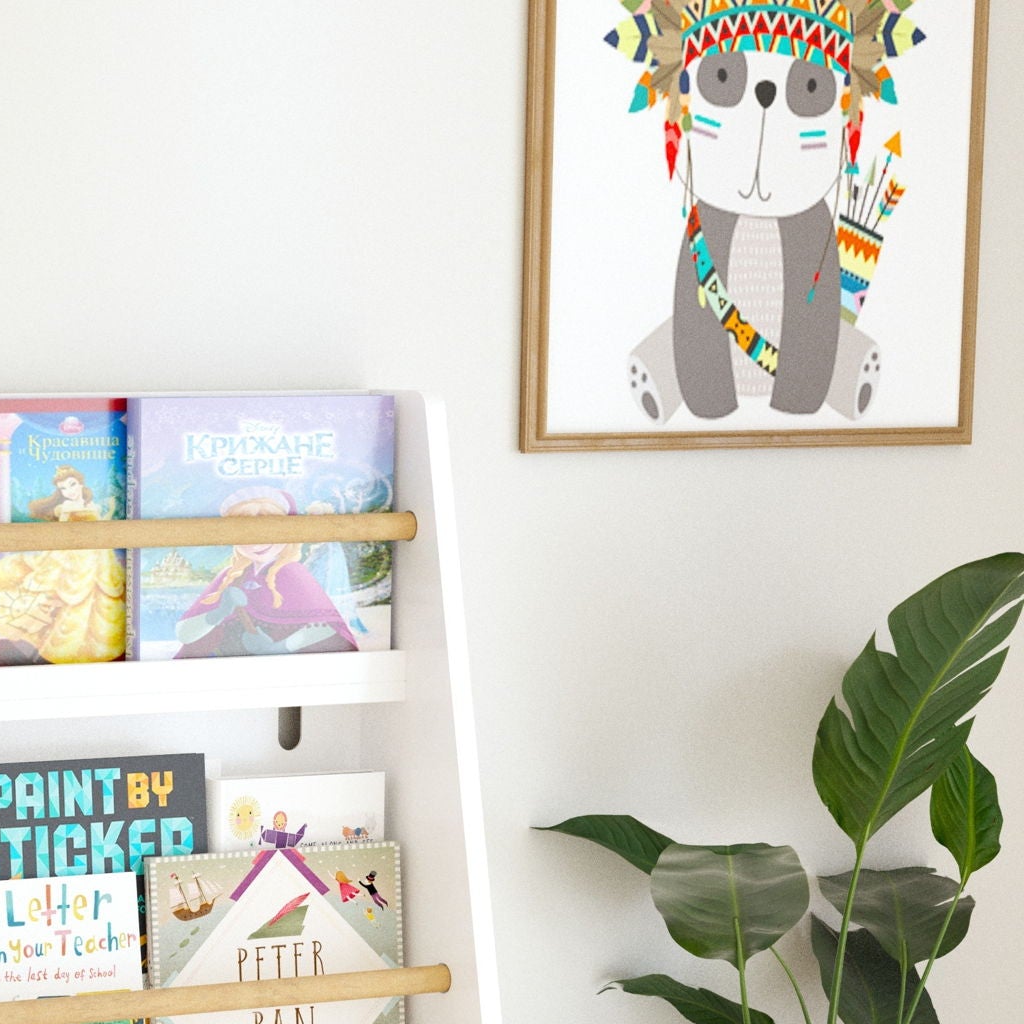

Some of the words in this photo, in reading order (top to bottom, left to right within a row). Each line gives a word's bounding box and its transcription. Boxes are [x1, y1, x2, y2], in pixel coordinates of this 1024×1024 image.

[27, 434, 120, 450] Красавица
[185, 432, 335, 462] КРИЖАНЕ
[217, 456, 303, 477] СЕРЦЕ
[126, 770, 174, 809] BY
[5, 883, 113, 927] Letter
[9, 938, 53, 964] your
[54, 921, 137, 957] Teacher
[4, 970, 22, 982] the
[27, 966, 48, 982] last
[54, 968, 70, 983] day
[74, 967, 86, 980] of
[88, 964, 117, 979] School
